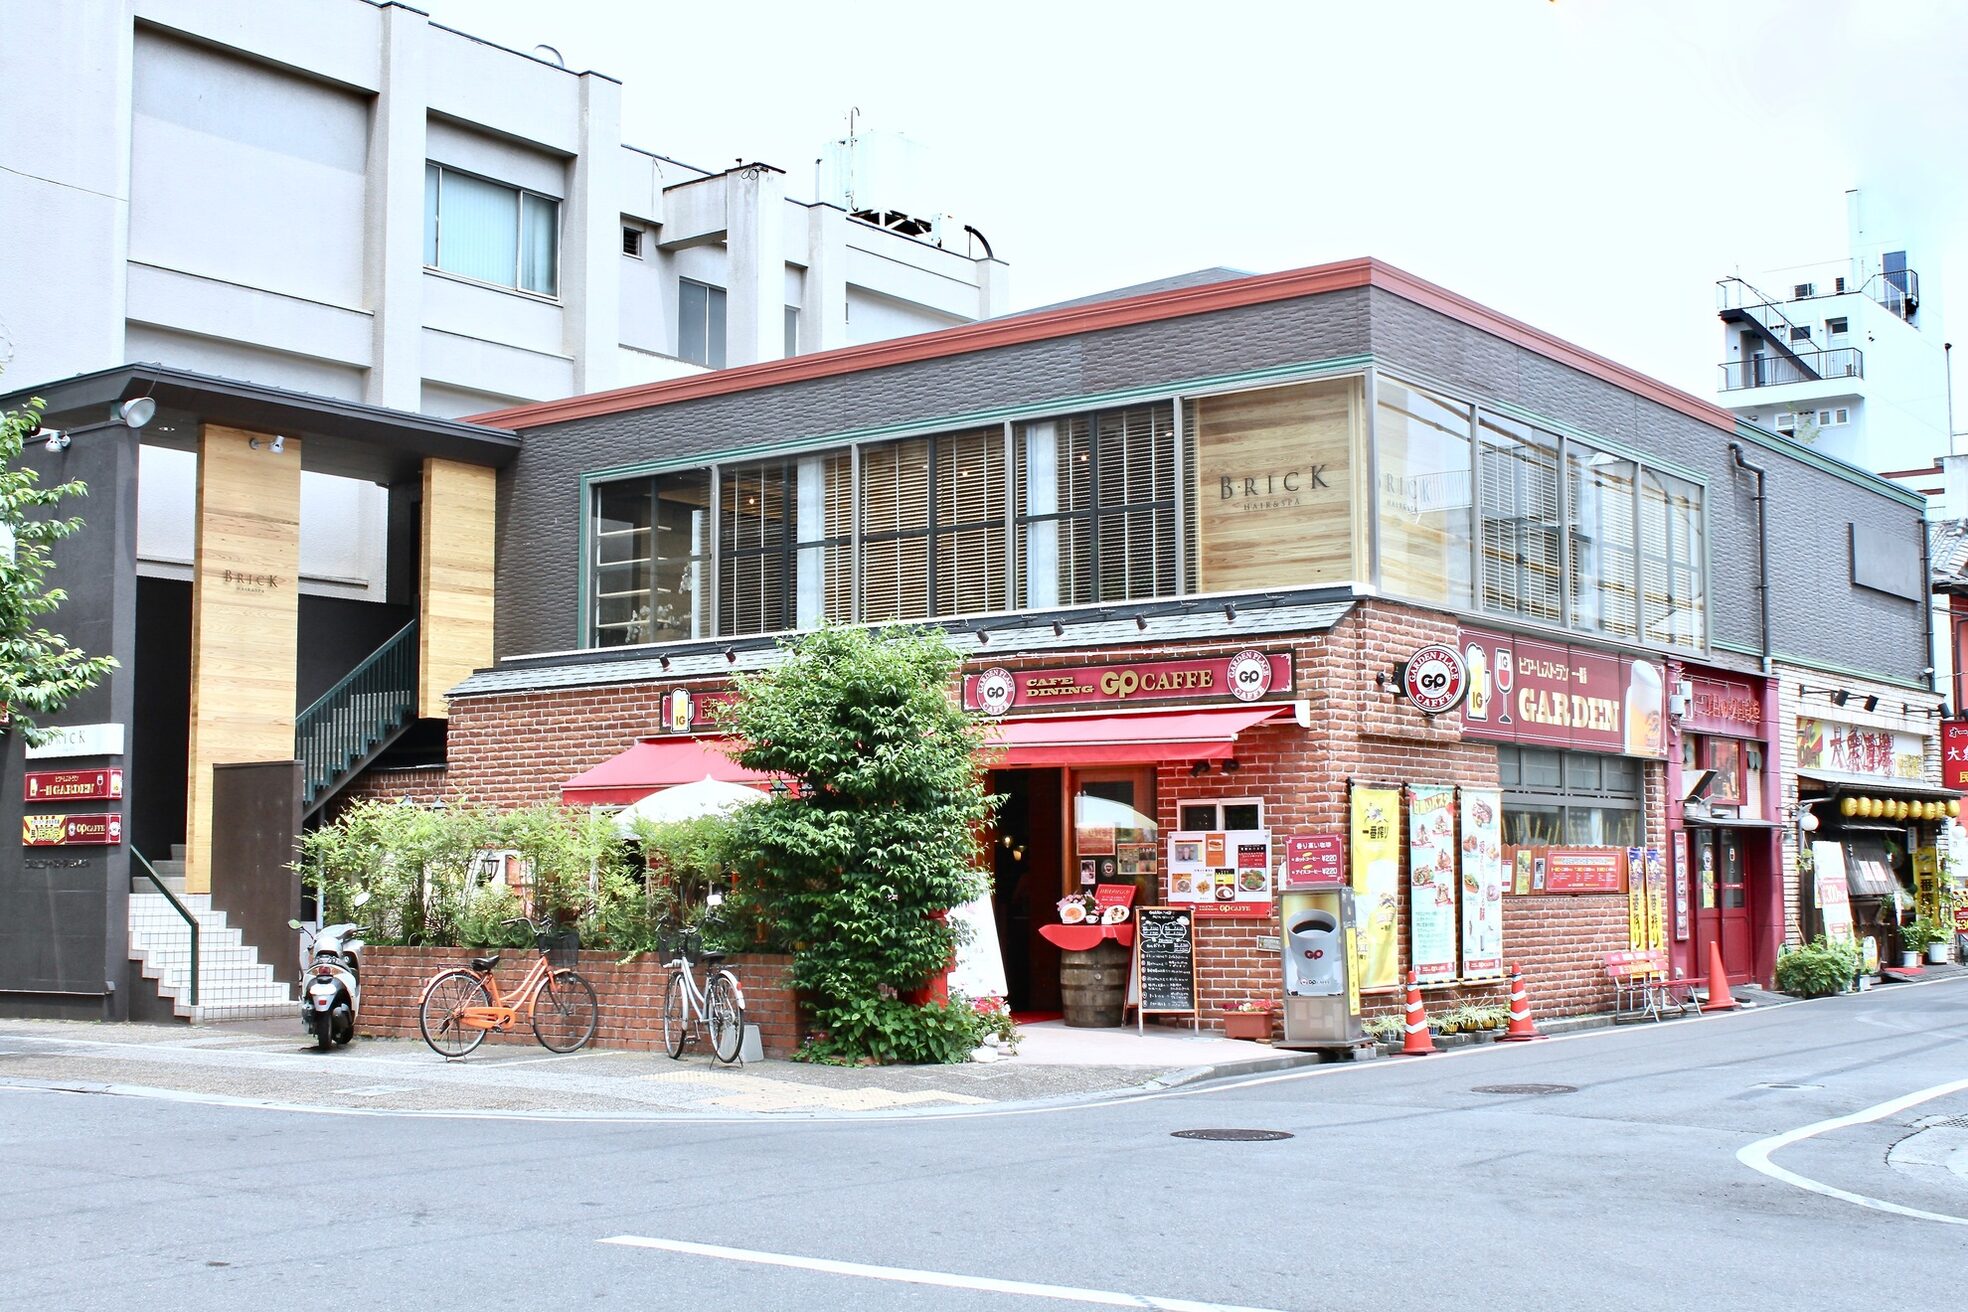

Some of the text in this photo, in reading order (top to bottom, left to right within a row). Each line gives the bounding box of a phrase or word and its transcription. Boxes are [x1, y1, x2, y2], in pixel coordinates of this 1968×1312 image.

[1220, 464, 1330, 499] BRICK
[1379, 473, 1431, 503] RICK
[224, 569, 278, 588] BRICK
[1229, 651, 1269, 678] GARDEN PLACE
[1409, 651, 1458, 682] GARDEN PLACE
[978, 669, 1014, 693] GARDEN PLACE
[1026, 676, 1074, 687] CAFE
[1140, 669, 1214, 691] CAFFE
[1026, 685, 1095, 697] DINING
[1416, 691, 1453, 706] CAFFE
[1472, 691, 1483, 709] IG
[1518, 687, 1620, 732] GARDEN
[675, 715, 686, 726] IG
[53, 783, 95, 796] GARDEN
